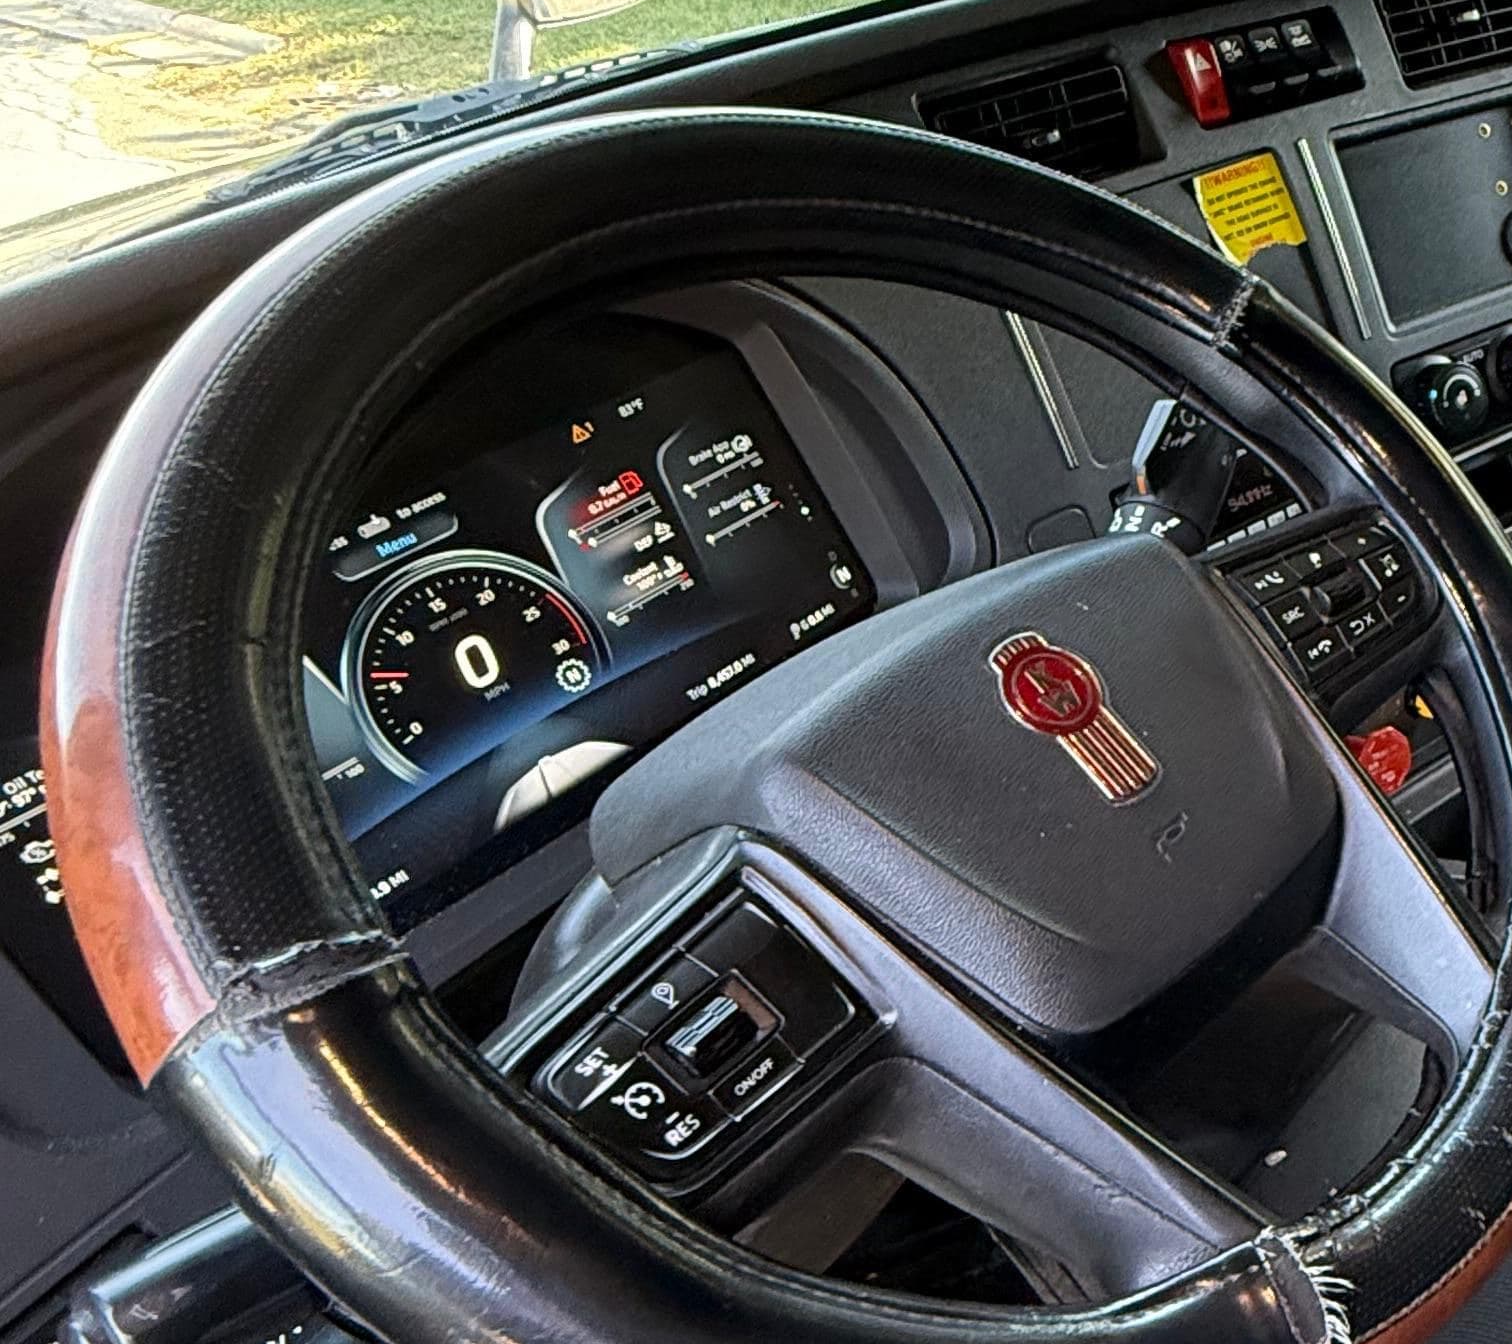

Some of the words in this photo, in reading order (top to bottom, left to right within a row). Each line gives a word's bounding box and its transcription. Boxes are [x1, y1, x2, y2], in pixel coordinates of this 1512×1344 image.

[598, 480, 621, 498] Fuel
[395, 507, 412, 519] to
[375, 532, 418, 558] Menu
[836, 565, 852, 584] N
[427, 597, 447, 614] 15
[475, 589, 496, 607] 20
[521, 606, 542, 623] 25
[1282, 606, 1305, 625] SRC
[395, 630, 415, 647] 10
[551, 638, 571, 656] 30
[454, 634, 500, 689] 0
[565, 667, 585, 684] N
[389, 681, 403, 695] 5
[483, 682, 511, 702] MPH
[686, 683, 708, 701] Trip
[408, 720, 424, 736] 0
[2, 776, 28, 795] Oil
[388, 868, 410, 888] MI
[574, 1047, 610, 1078] SET
[734, 1058, 775, 1097] ON/OFF
[664, 1113, 701, 1147] RES
